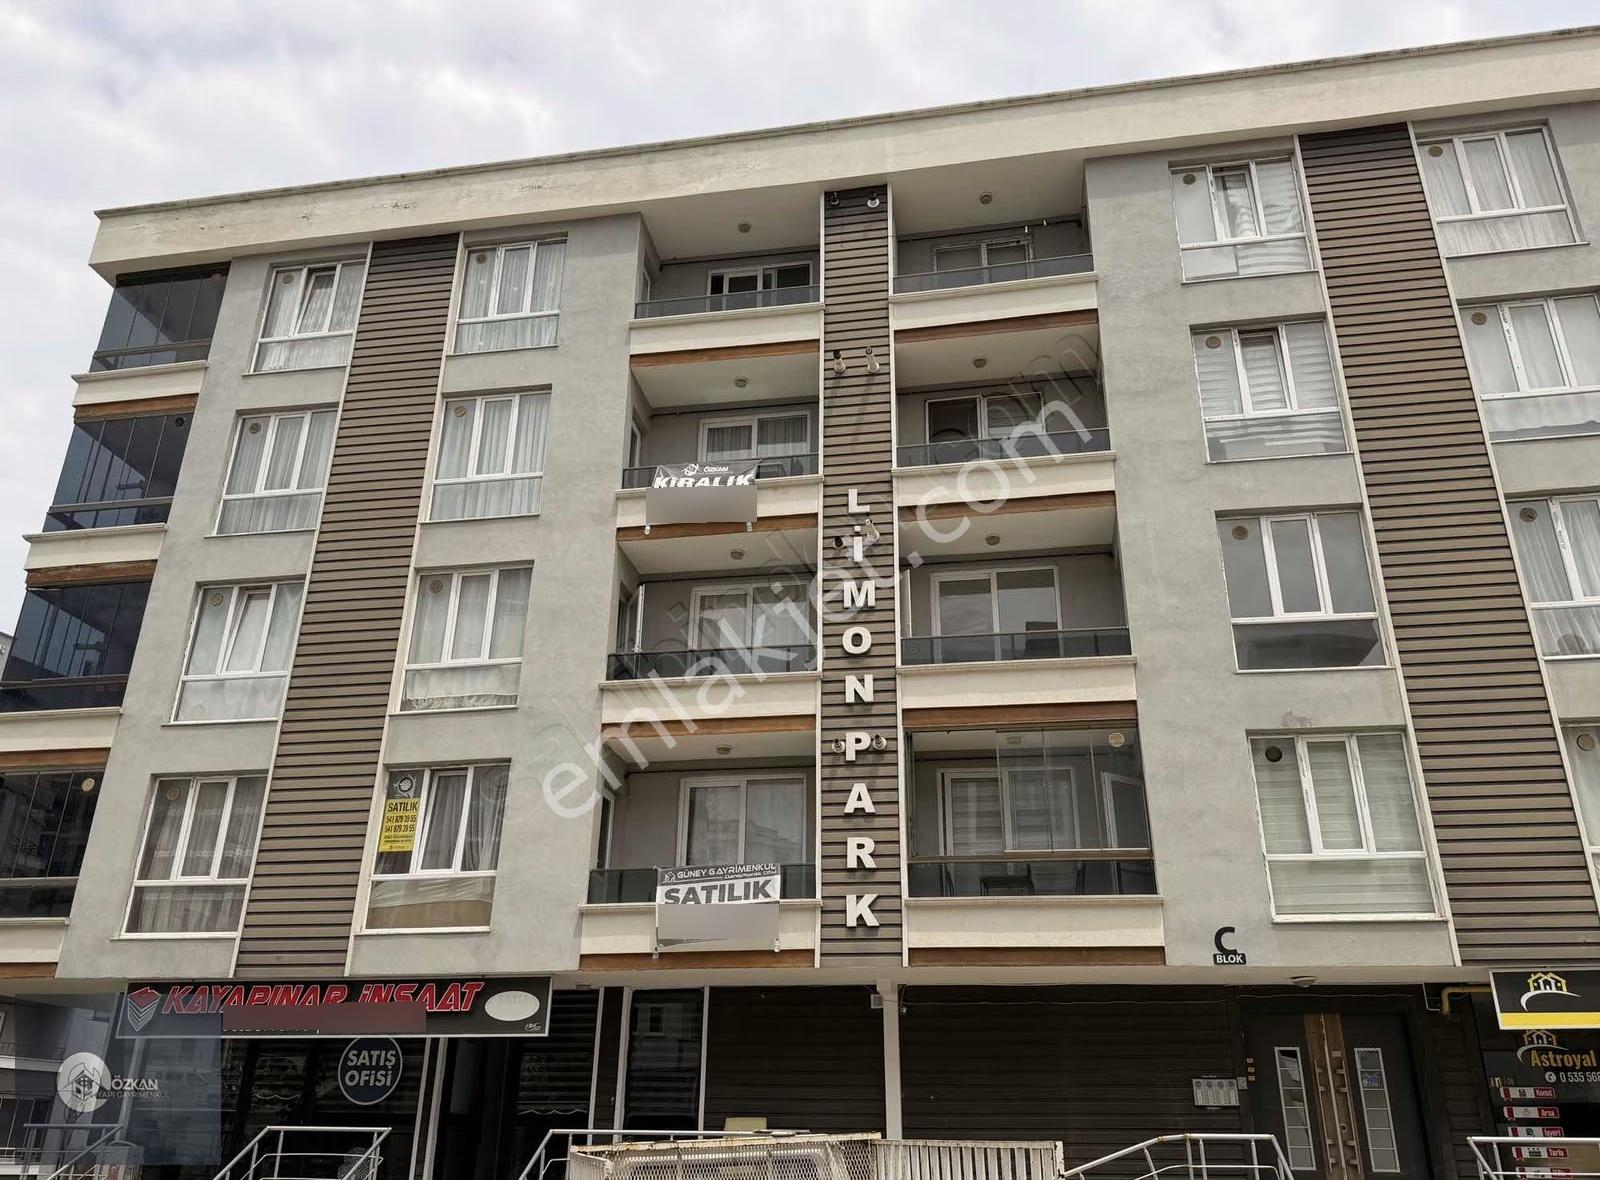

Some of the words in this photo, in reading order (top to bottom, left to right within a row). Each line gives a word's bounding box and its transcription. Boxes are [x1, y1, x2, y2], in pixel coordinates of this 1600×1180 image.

[388, 802, 418, 812] SATILIK
[844, 731, 880, 928] PARK
[677, 869, 707, 879] GÜNEY
[1214, 926, 1238, 954] C
[1216, 954, 1244, 964] BLOK
[346, 1050, 396, 1069] SATIŞ
[1530, 1049, 1598, 1069] Astroyal
[1567, 1071, 1585, 1083] 535
